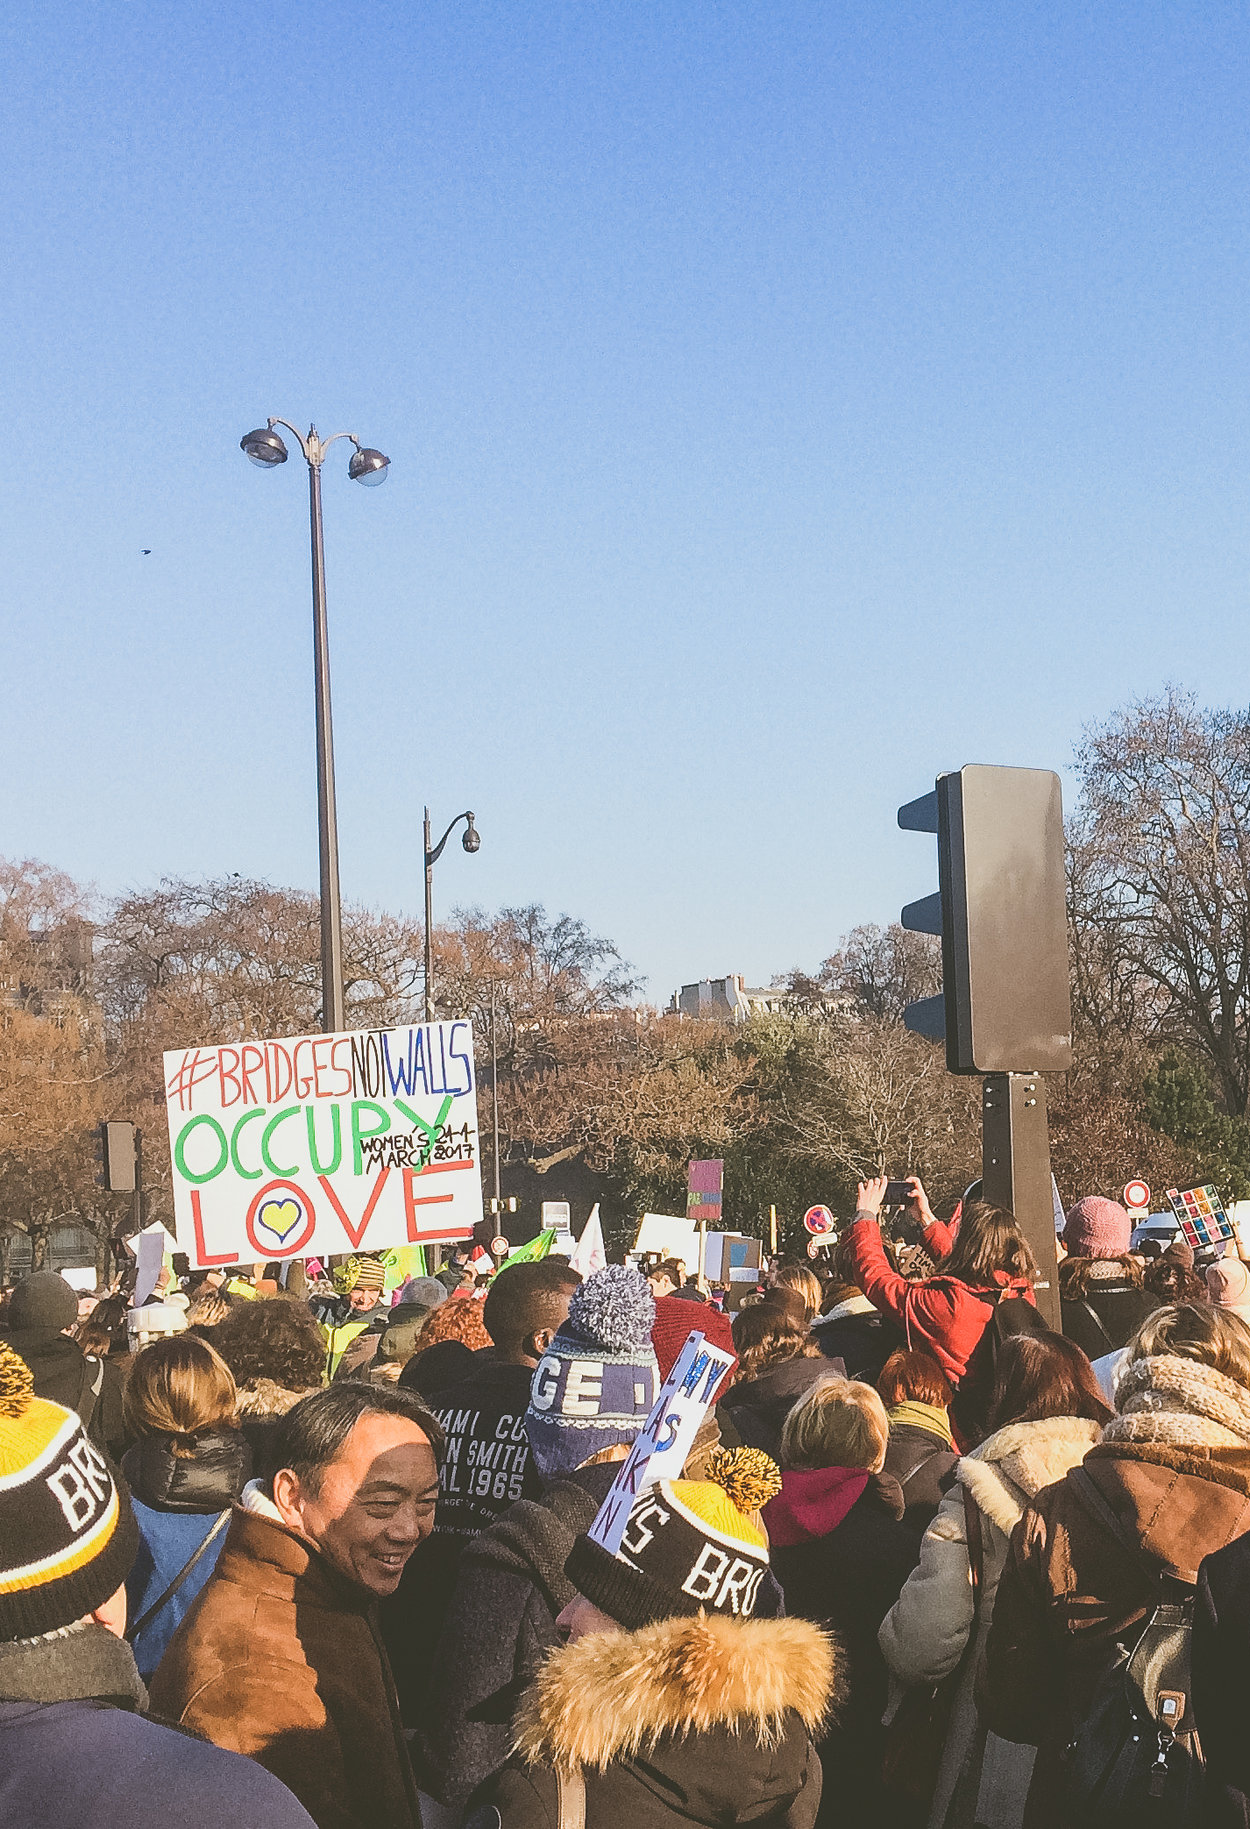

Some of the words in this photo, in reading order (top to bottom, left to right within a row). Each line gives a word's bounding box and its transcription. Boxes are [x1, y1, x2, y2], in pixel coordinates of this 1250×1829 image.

[175, 1095, 454, 1185] OCCUPY
[366, 1149, 431, 1175] MARCH
[434, 1144, 474, 1160] 2017
[190, 1159, 475, 1266] LOVE
[46, 1427, 109, 1532] BR
[439, 1464, 460, 1492] AL
[467, 1468, 524, 1500] 1965
[466, 1440, 529, 1473] SMITH
[681, 1541, 767, 1616] BRU
